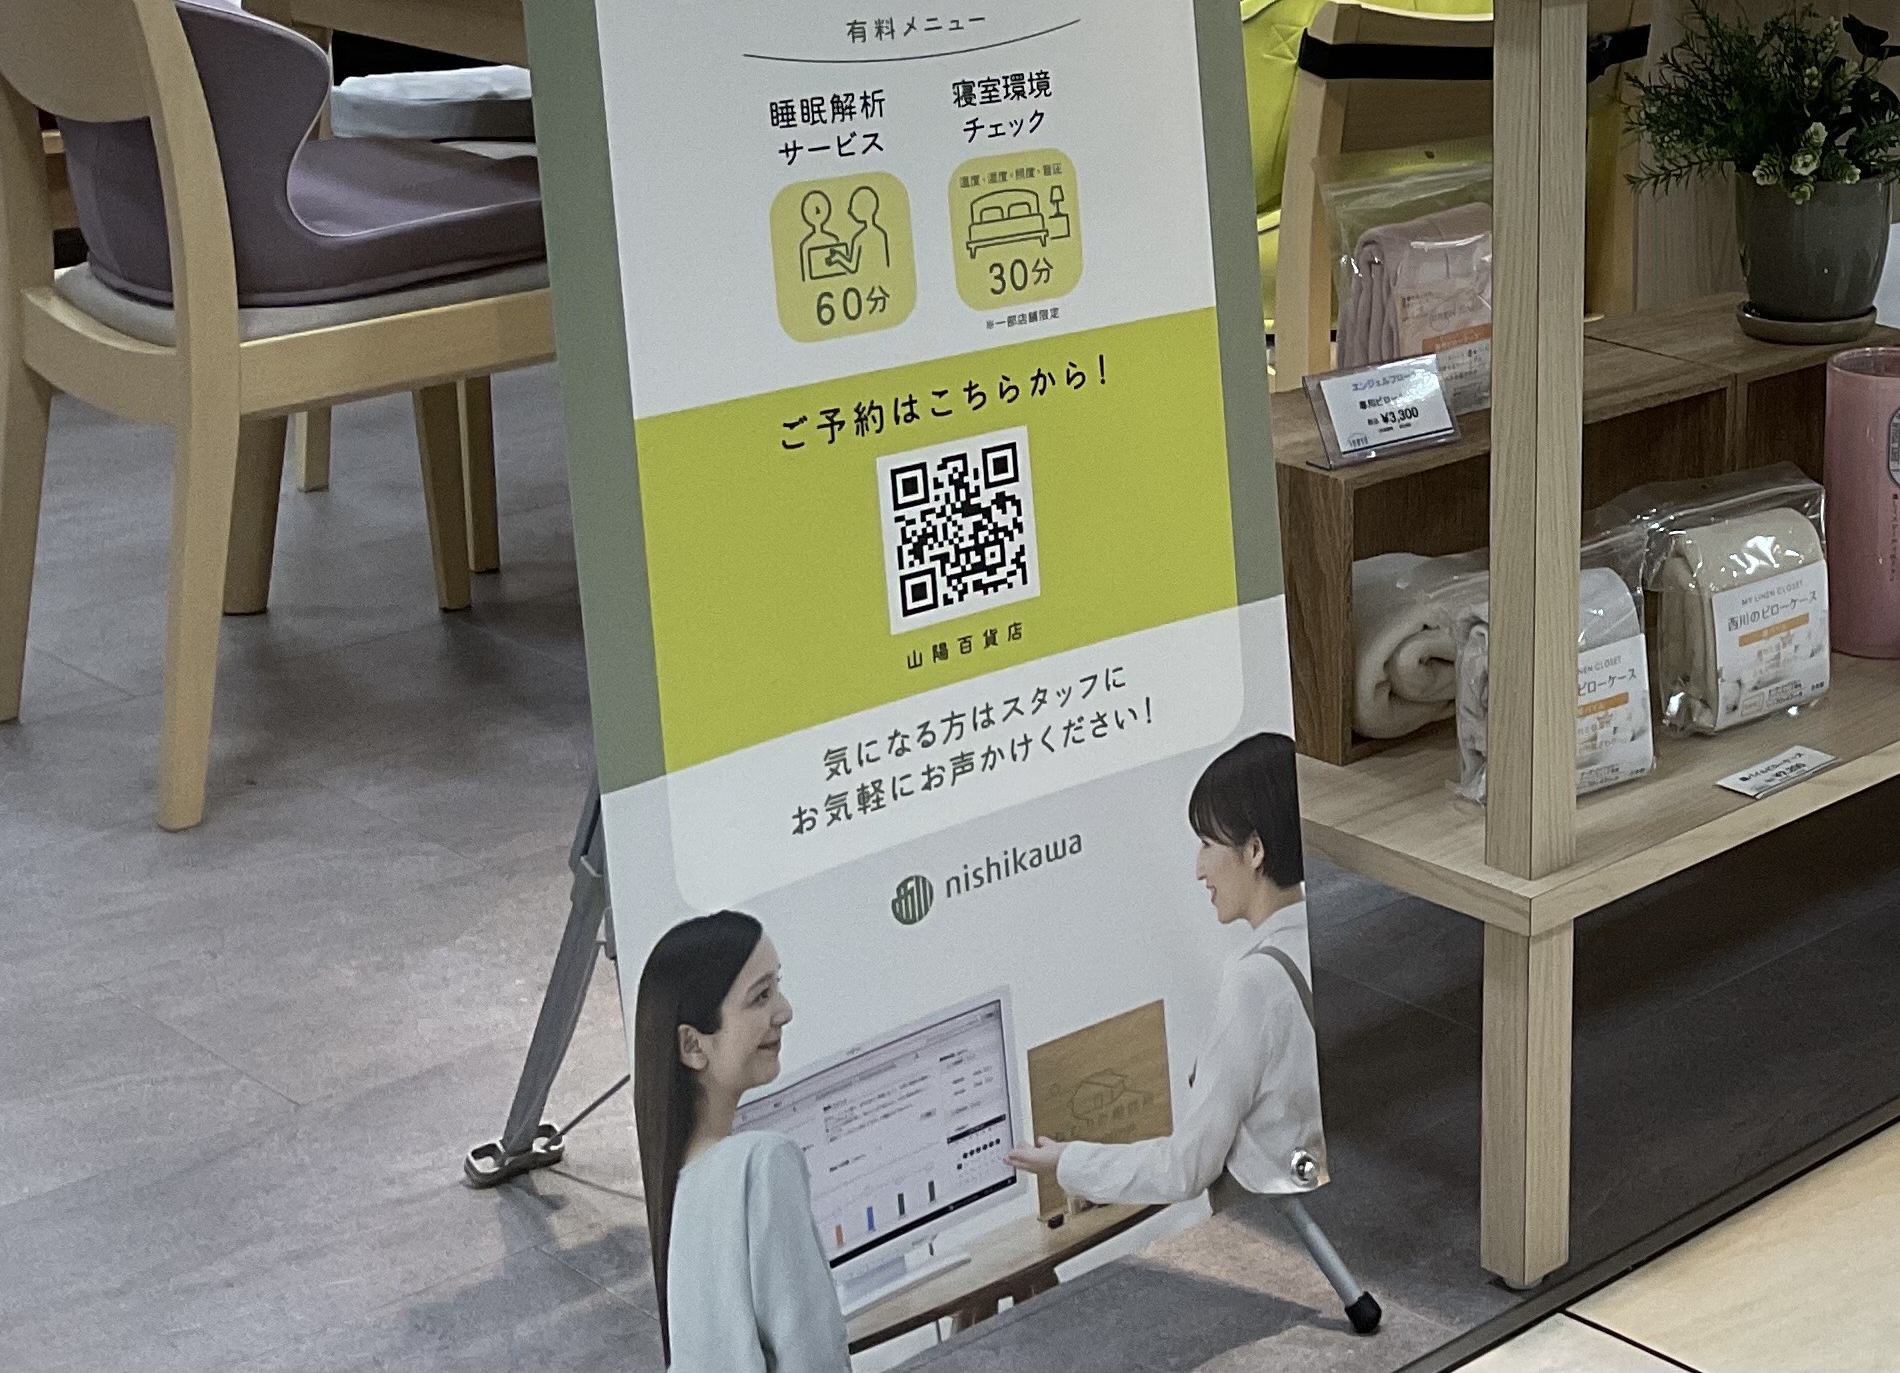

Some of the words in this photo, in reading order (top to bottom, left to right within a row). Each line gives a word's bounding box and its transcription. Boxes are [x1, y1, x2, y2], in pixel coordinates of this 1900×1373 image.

[846, 13, 986, 44] 有料メニュー
[769, 88, 887, 131] 睡眠解析
[951, 69, 1054, 109] 寝室環境
[962, 109, 1046, 144] チェック
[778, 130, 884, 167] サービス
[988, 256, 1054, 296] 30分
[816, 285, 891, 327] 60分
[780, 354, 1107, 452] ご予約はこちらから!
[1380, 407, 1419, 424] ¥3,300
[1728, 590, 1818, 632] 西川のピローケース
[1741, 596, 1754, 606] MY
[1754, 590, 1777, 603] LINEN
[1776, 580, 1804, 595] CLOSET
[905, 621, 1025, 670] 山陽百貨店
[822, 664, 1127, 782] 気になる方はスタッフに
[790, 696, 1153, 837] お気軽にお声かけください!
[945, 832, 1084, 901] nishikawa
